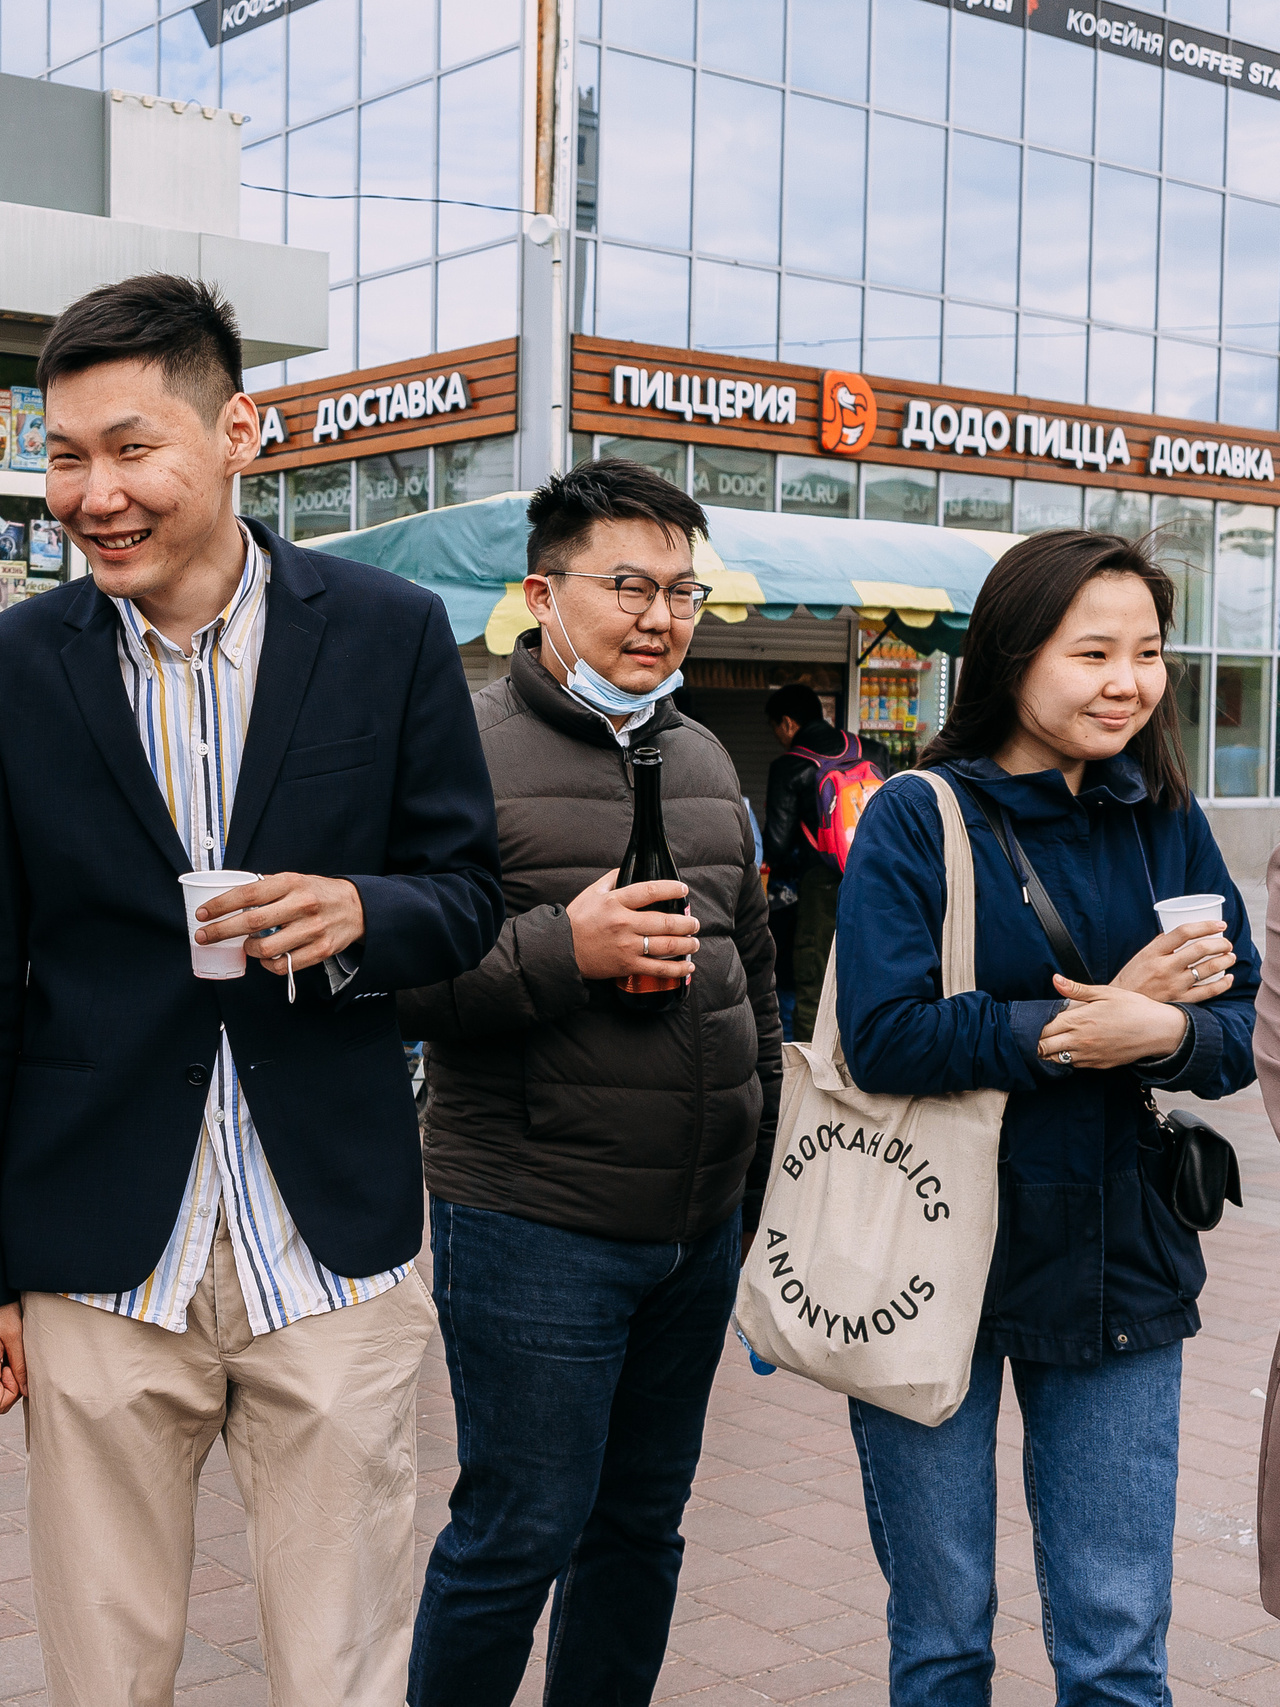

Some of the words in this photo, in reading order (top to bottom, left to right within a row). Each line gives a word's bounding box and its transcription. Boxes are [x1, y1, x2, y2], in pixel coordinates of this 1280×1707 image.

[1066, 9, 1164, 56] КОФЕЙНЯ
[1169, 38, 1245, 79] COFFEE
[313, 371, 468, 444] ДОСТАВКА
[613, 364, 797, 425] ПИЦЦЕРИЯ
[902, 399, 1011, 457] ДОДО
[1016, 413, 1131, 473] ПИЦЦА
[1149, 435, 1275, 482] ДОСТАВКА
[782, 1120, 951, 1223] BOOKAHOLICS
[766, 1227, 936, 1345] ANONYMOUS
